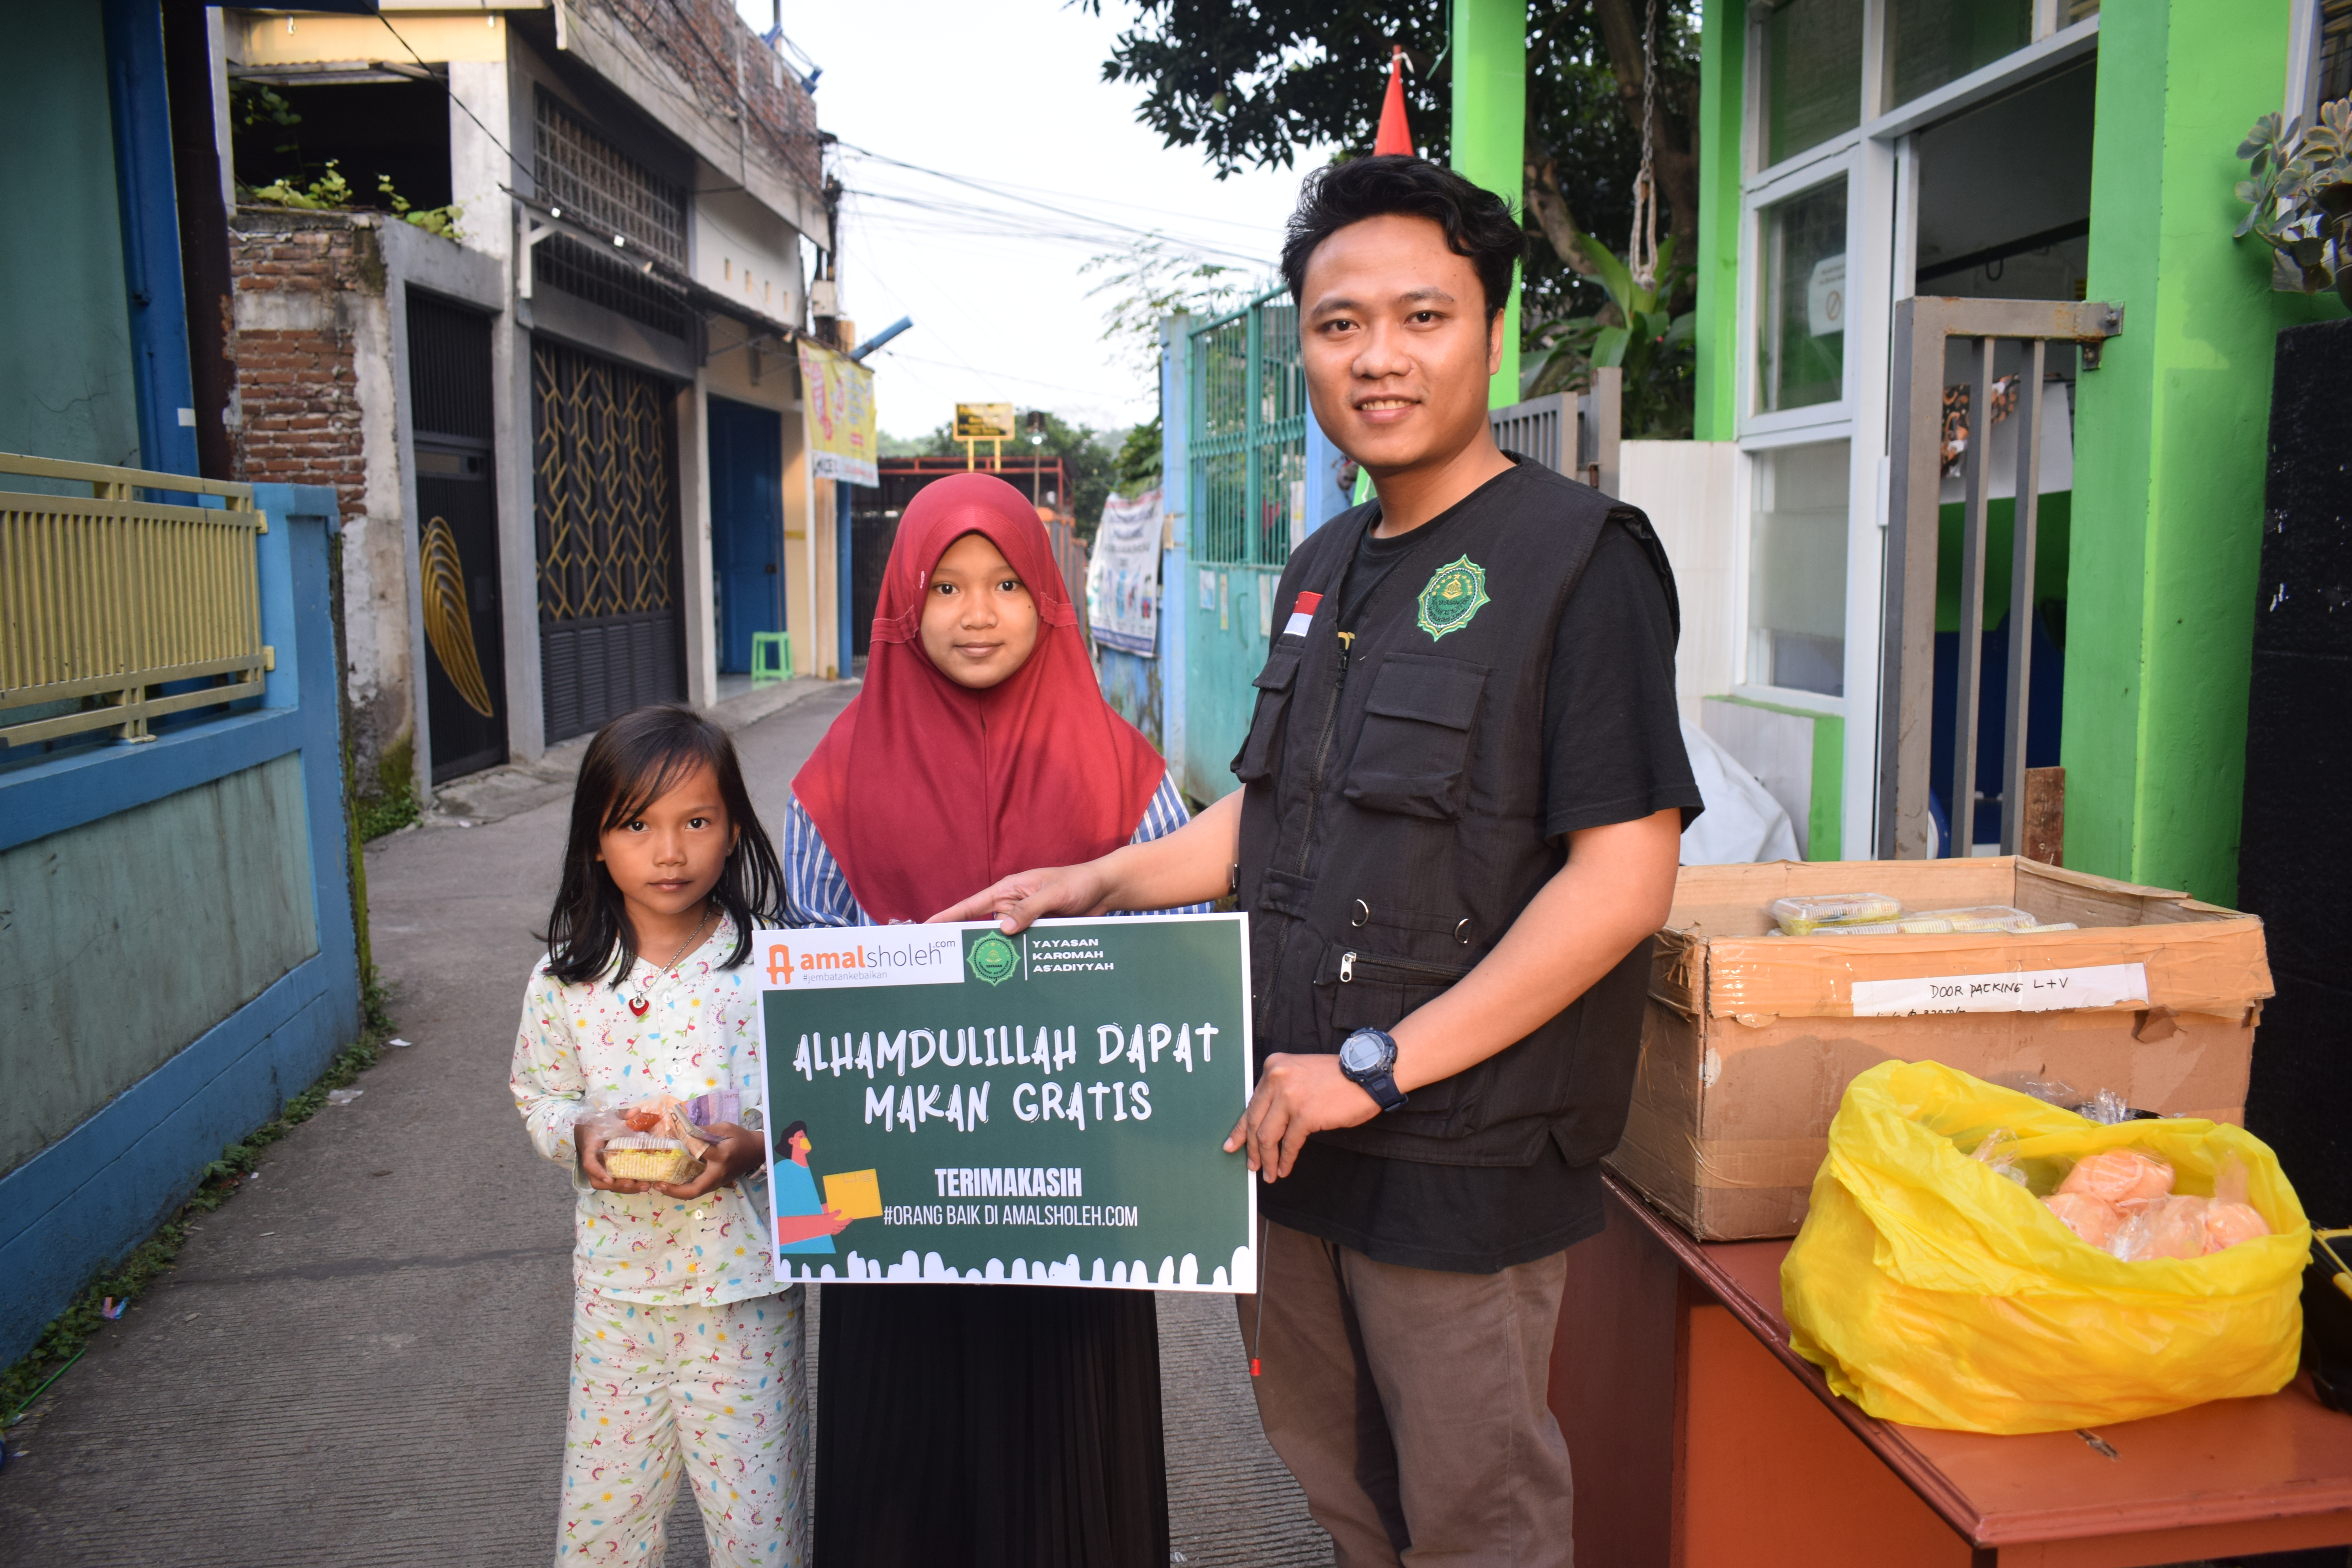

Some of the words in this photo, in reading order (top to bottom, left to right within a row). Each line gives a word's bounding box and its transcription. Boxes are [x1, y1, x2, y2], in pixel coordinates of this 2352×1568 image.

[1032, 938, 1099, 948] YAYASAN
[1033, 951, 1103, 960] KAROMAH
[1033, 963, 1114, 973] AS'ADIYYAH
[803, 970, 887, 984] #jembatankebaikan
[1930, 984, 1964, 998] DOOR
[1969, 983, 2023, 998] PACKING
[793, 1025, 1076, 1082] ALHAMDULILLAH
[1097, 1022, 1219, 1073] DAPAT
[865, 1081, 991, 1133] MAKAN
[1013, 1081, 1152, 1131] GRATIS
[935, 1167, 1082, 1197] TERIMAKASIH
[883, 1205, 942, 1225] #ORANG
[947, 1205, 981, 1225] BAIK
[985, 1205, 998, 1225] DI
[1002, 1205, 1138, 1227] AMALSHOLEH.COM
